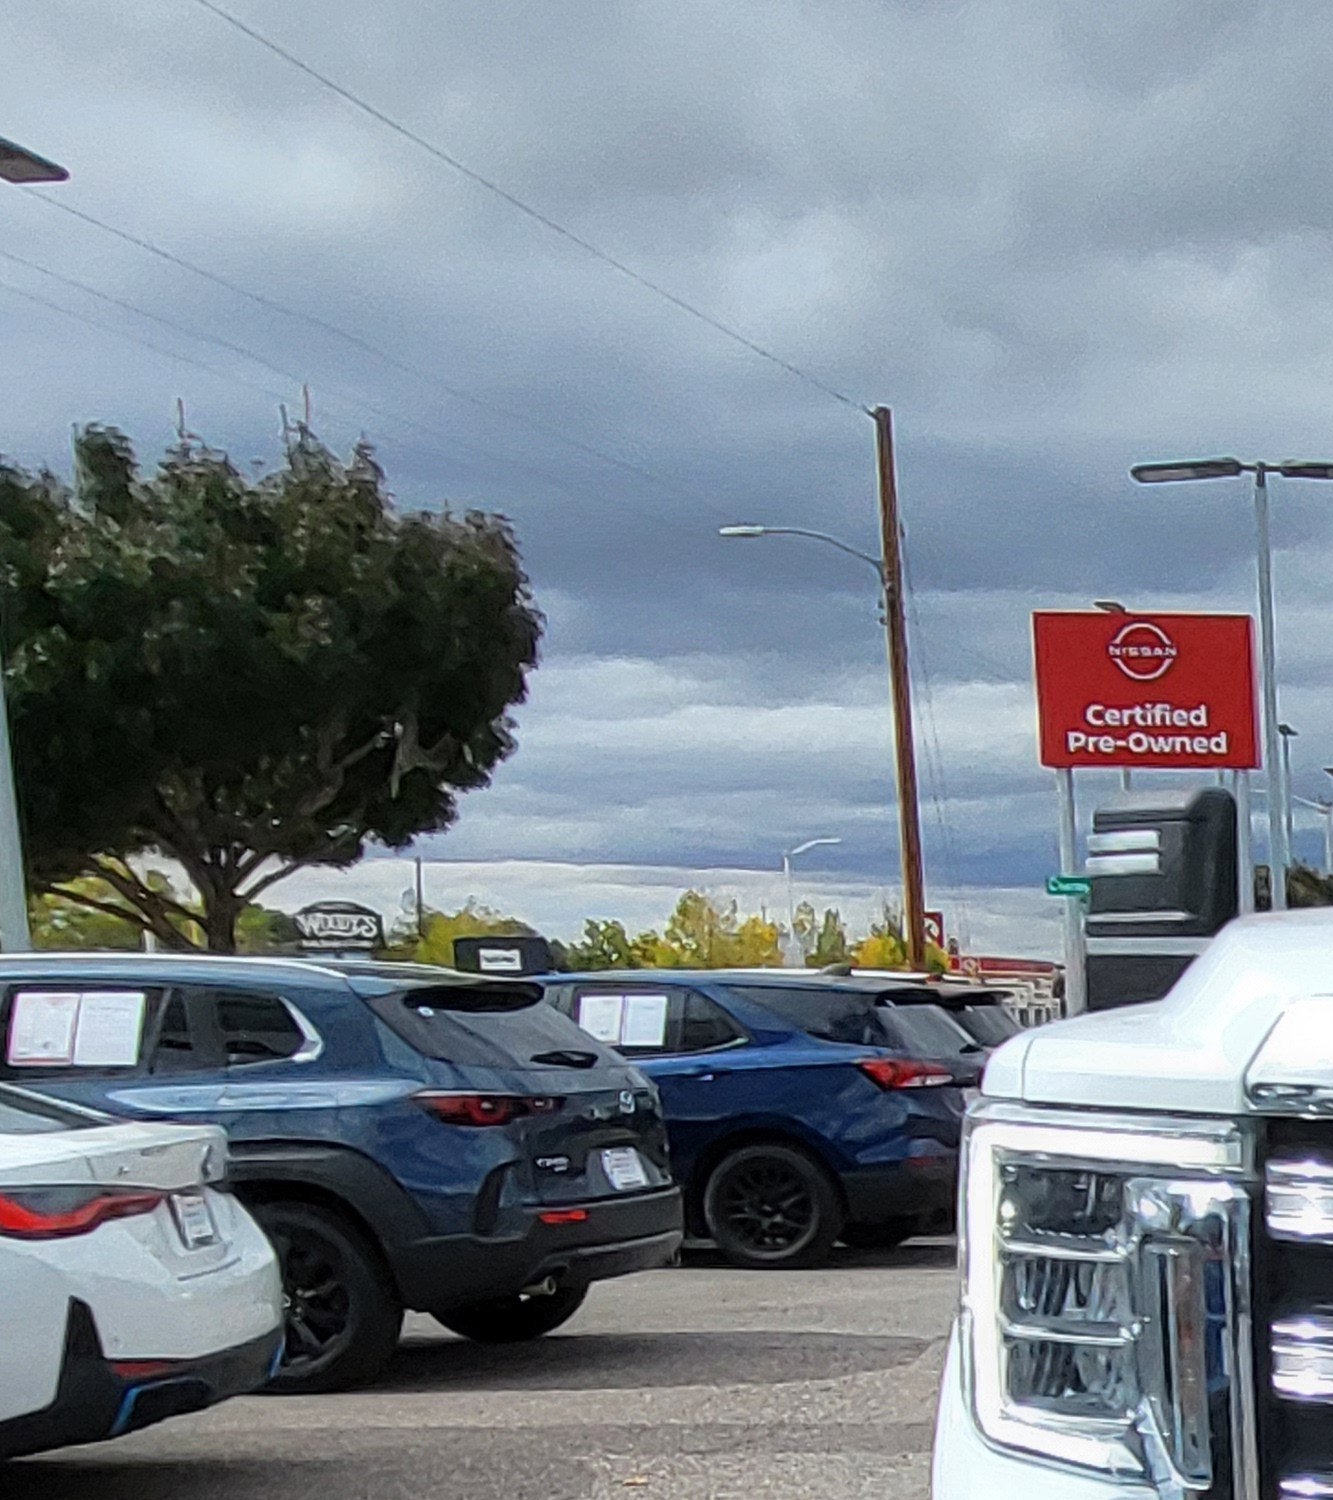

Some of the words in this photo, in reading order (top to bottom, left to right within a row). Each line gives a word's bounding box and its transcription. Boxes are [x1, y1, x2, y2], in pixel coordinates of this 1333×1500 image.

[1108, 645, 1178, 657] NISSAN
[1085, 703, 1208, 727] Certified
[1066, 732, 1229, 755] Pre-Owned
